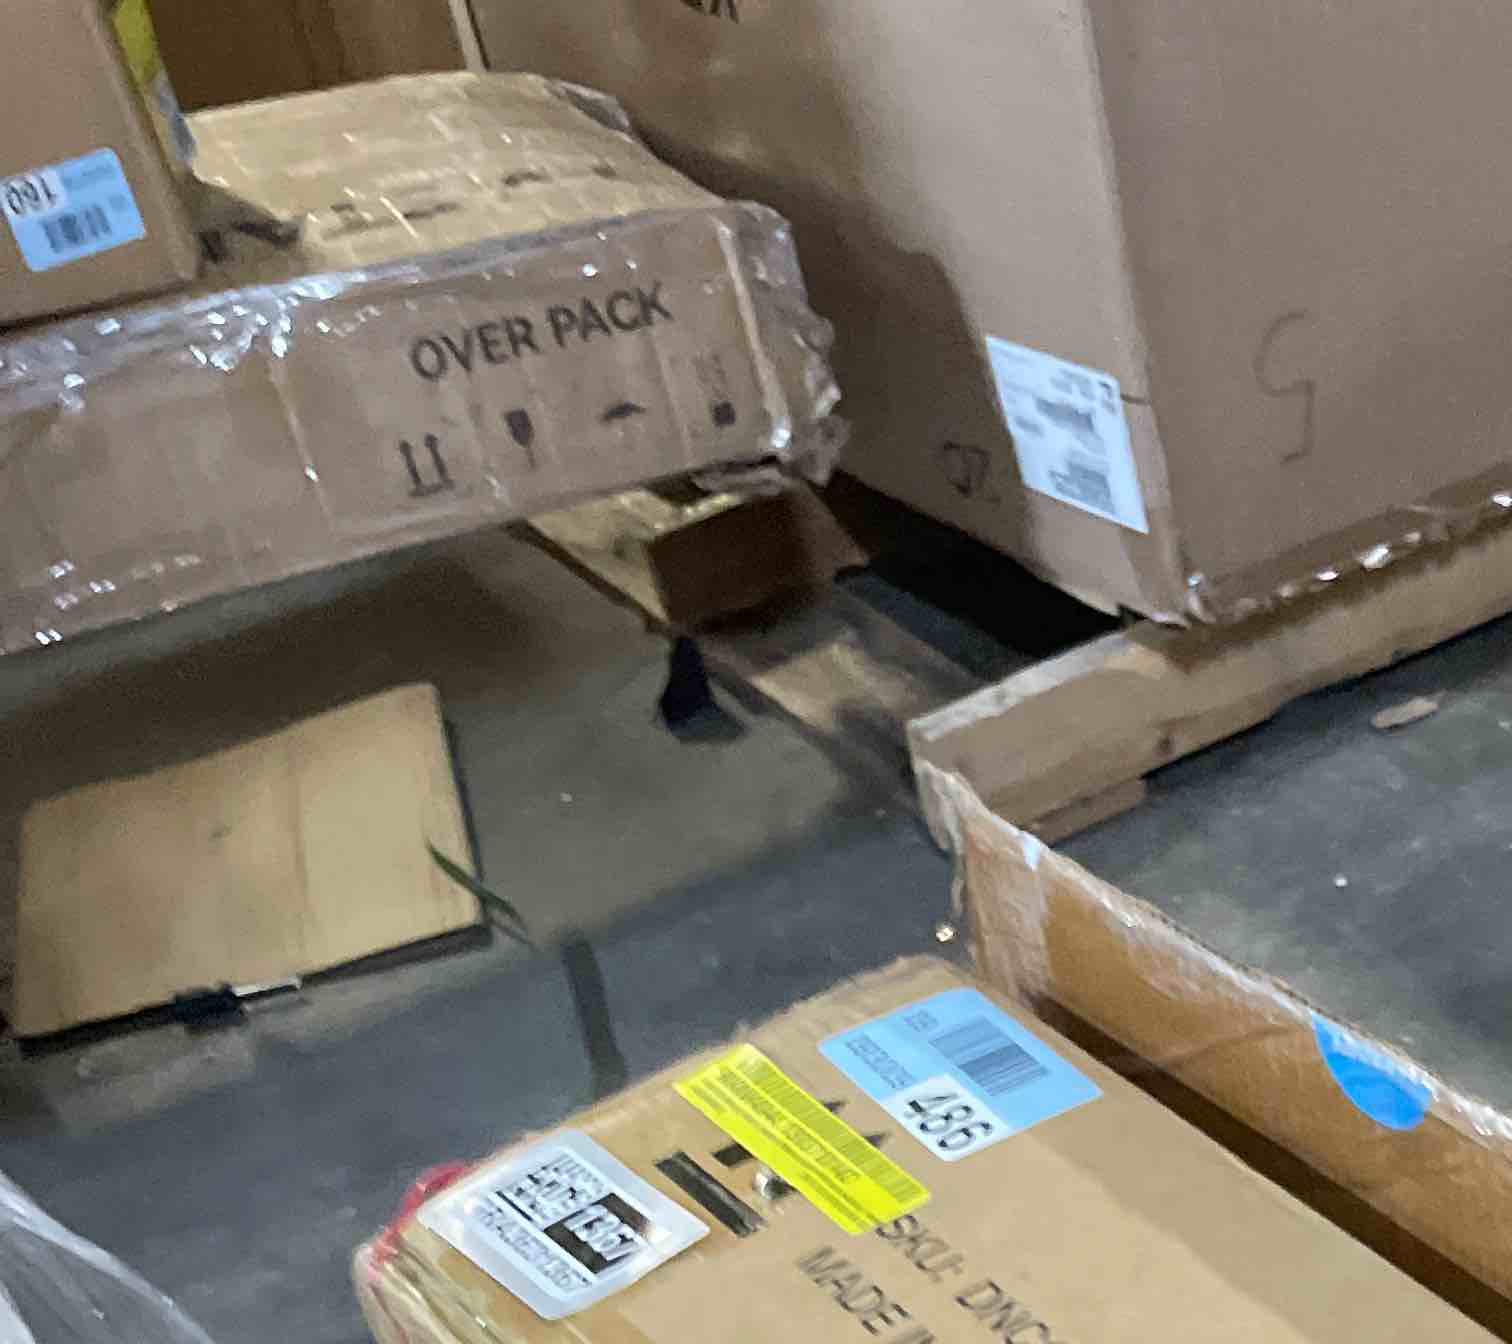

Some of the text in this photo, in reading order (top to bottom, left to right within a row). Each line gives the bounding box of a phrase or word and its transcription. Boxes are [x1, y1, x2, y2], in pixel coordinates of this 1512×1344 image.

[411, 279, 674, 382] OVER PACK
[903, 1091, 993, 1150] 486
[875, 1213, 964, 1284] SKU:
[794, 1244, 911, 1336] MADE
